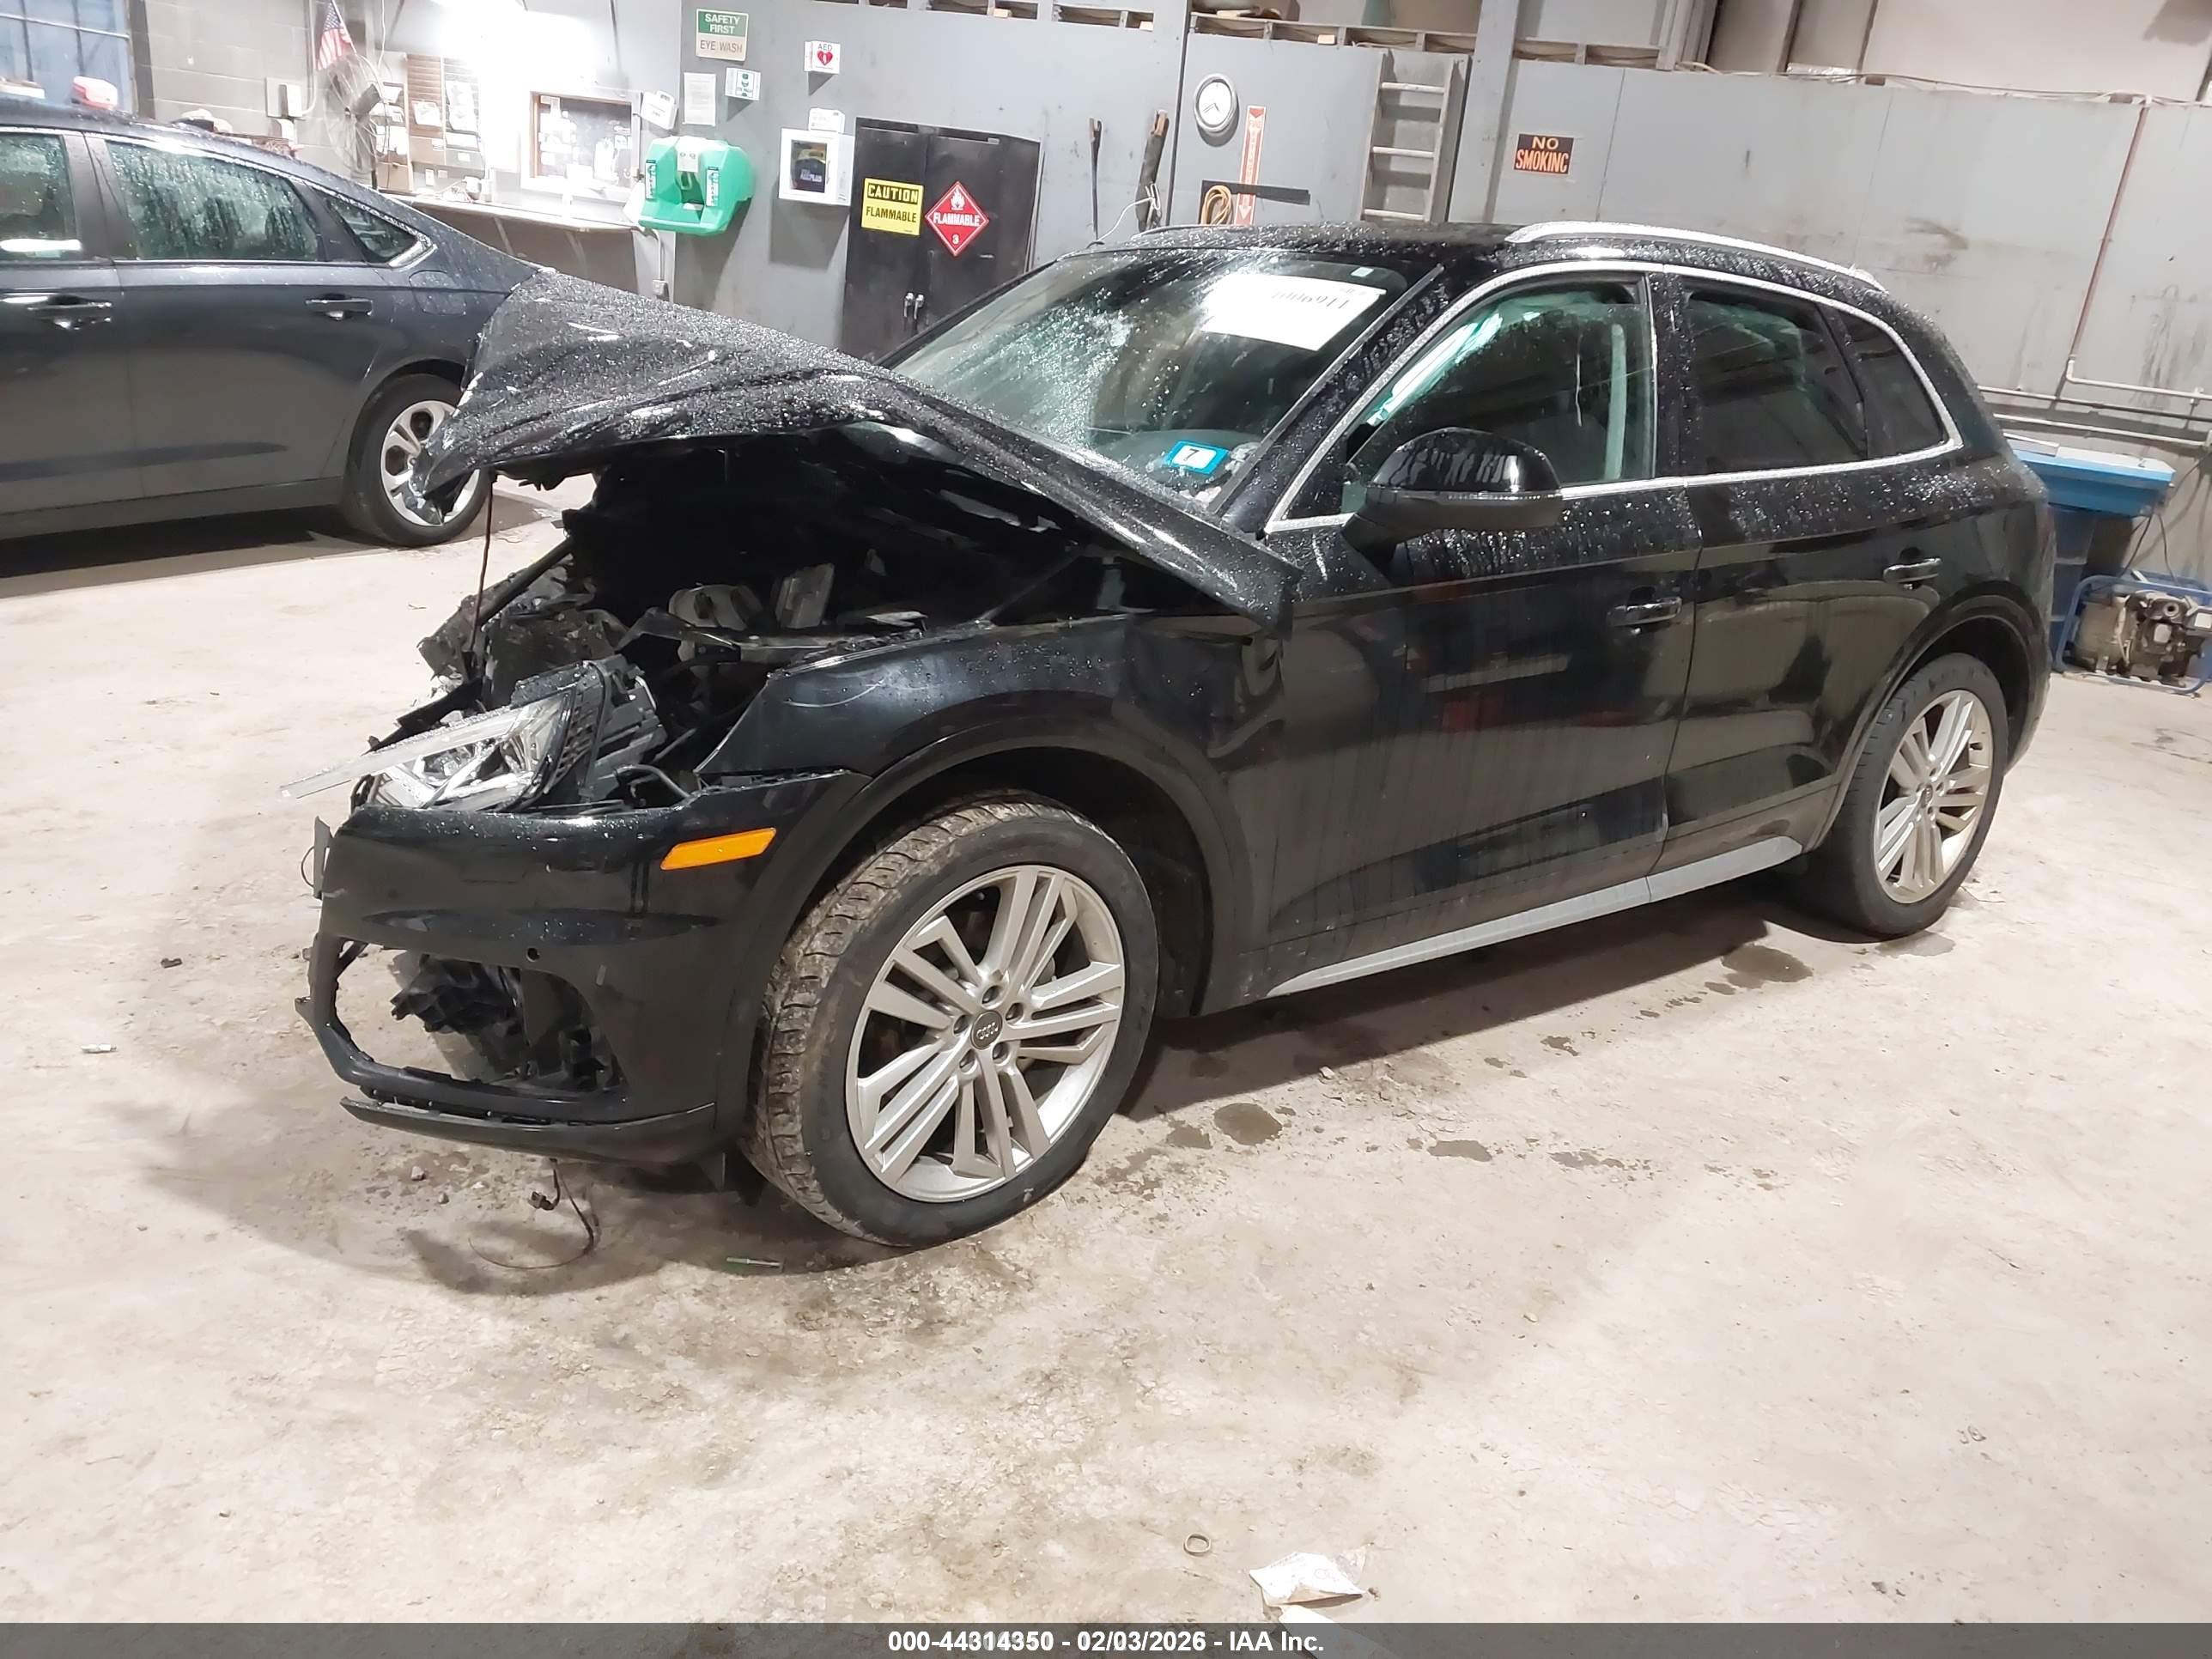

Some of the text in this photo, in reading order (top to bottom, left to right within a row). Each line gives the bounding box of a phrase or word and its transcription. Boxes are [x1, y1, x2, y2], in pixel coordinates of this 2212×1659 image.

[704, 13, 739, 26] SAFETY
[709, 23, 735, 34] FIRST
[700, 40, 743, 53] EYE WASH
[817, 43, 833, 52] AED
[1532, 136, 1559, 150] NO
[1516, 149, 1569, 173] SMOKING
[867, 184, 919, 204] CAUTION
[866, 206, 917, 223] FLAMMABLE
[933, 211, 981, 228] FLAMMABLE
[951, 234, 960, 245] 3
[1182, 447, 1200, 462] 7
